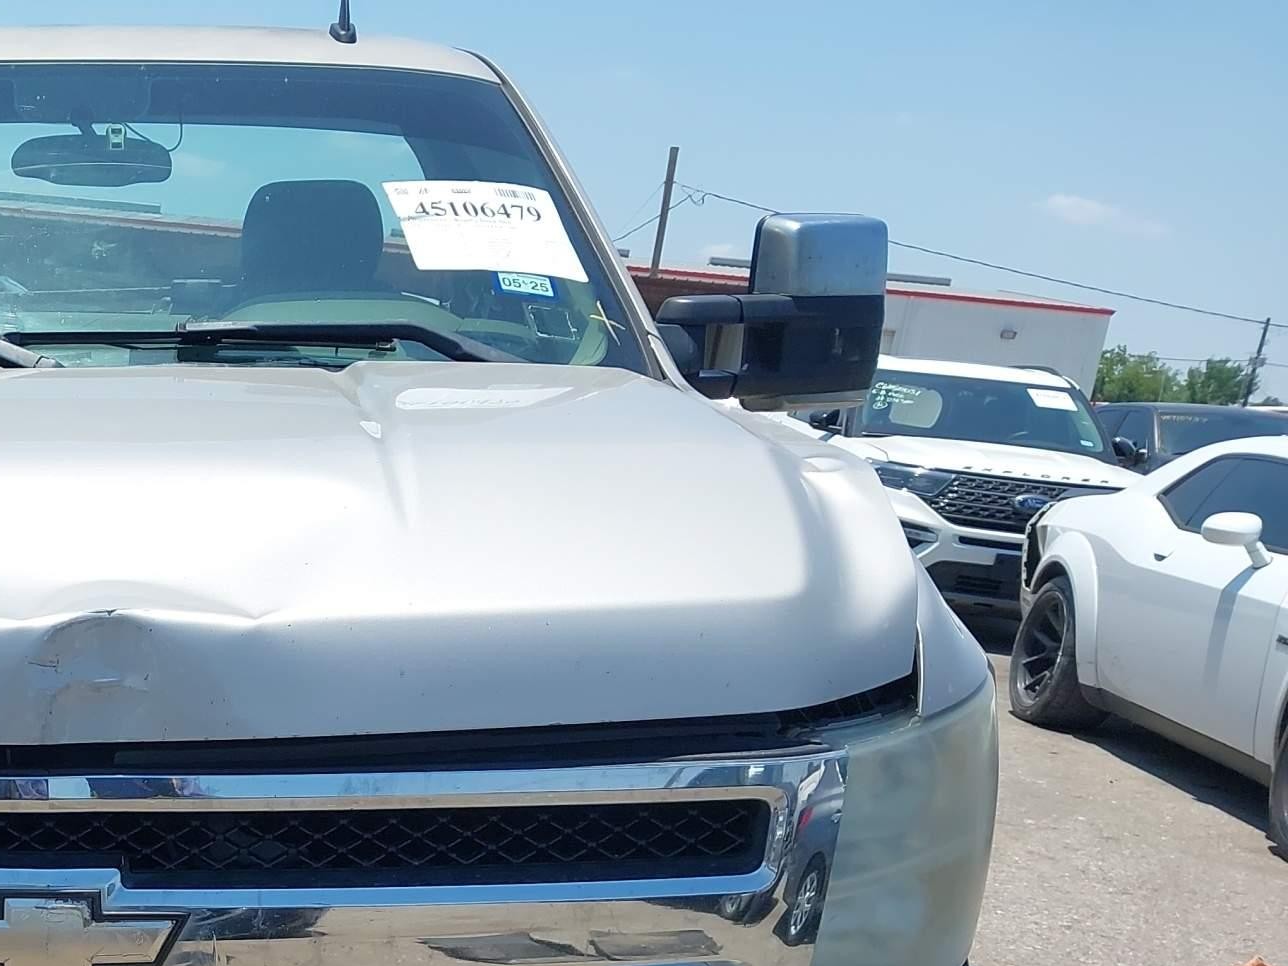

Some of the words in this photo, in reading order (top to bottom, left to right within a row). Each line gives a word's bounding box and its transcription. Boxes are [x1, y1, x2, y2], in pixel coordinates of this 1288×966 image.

[414, 200, 542, 222] 45106479
[501, 277, 521, 289] 05
[529, 280, 549, 292] 25
